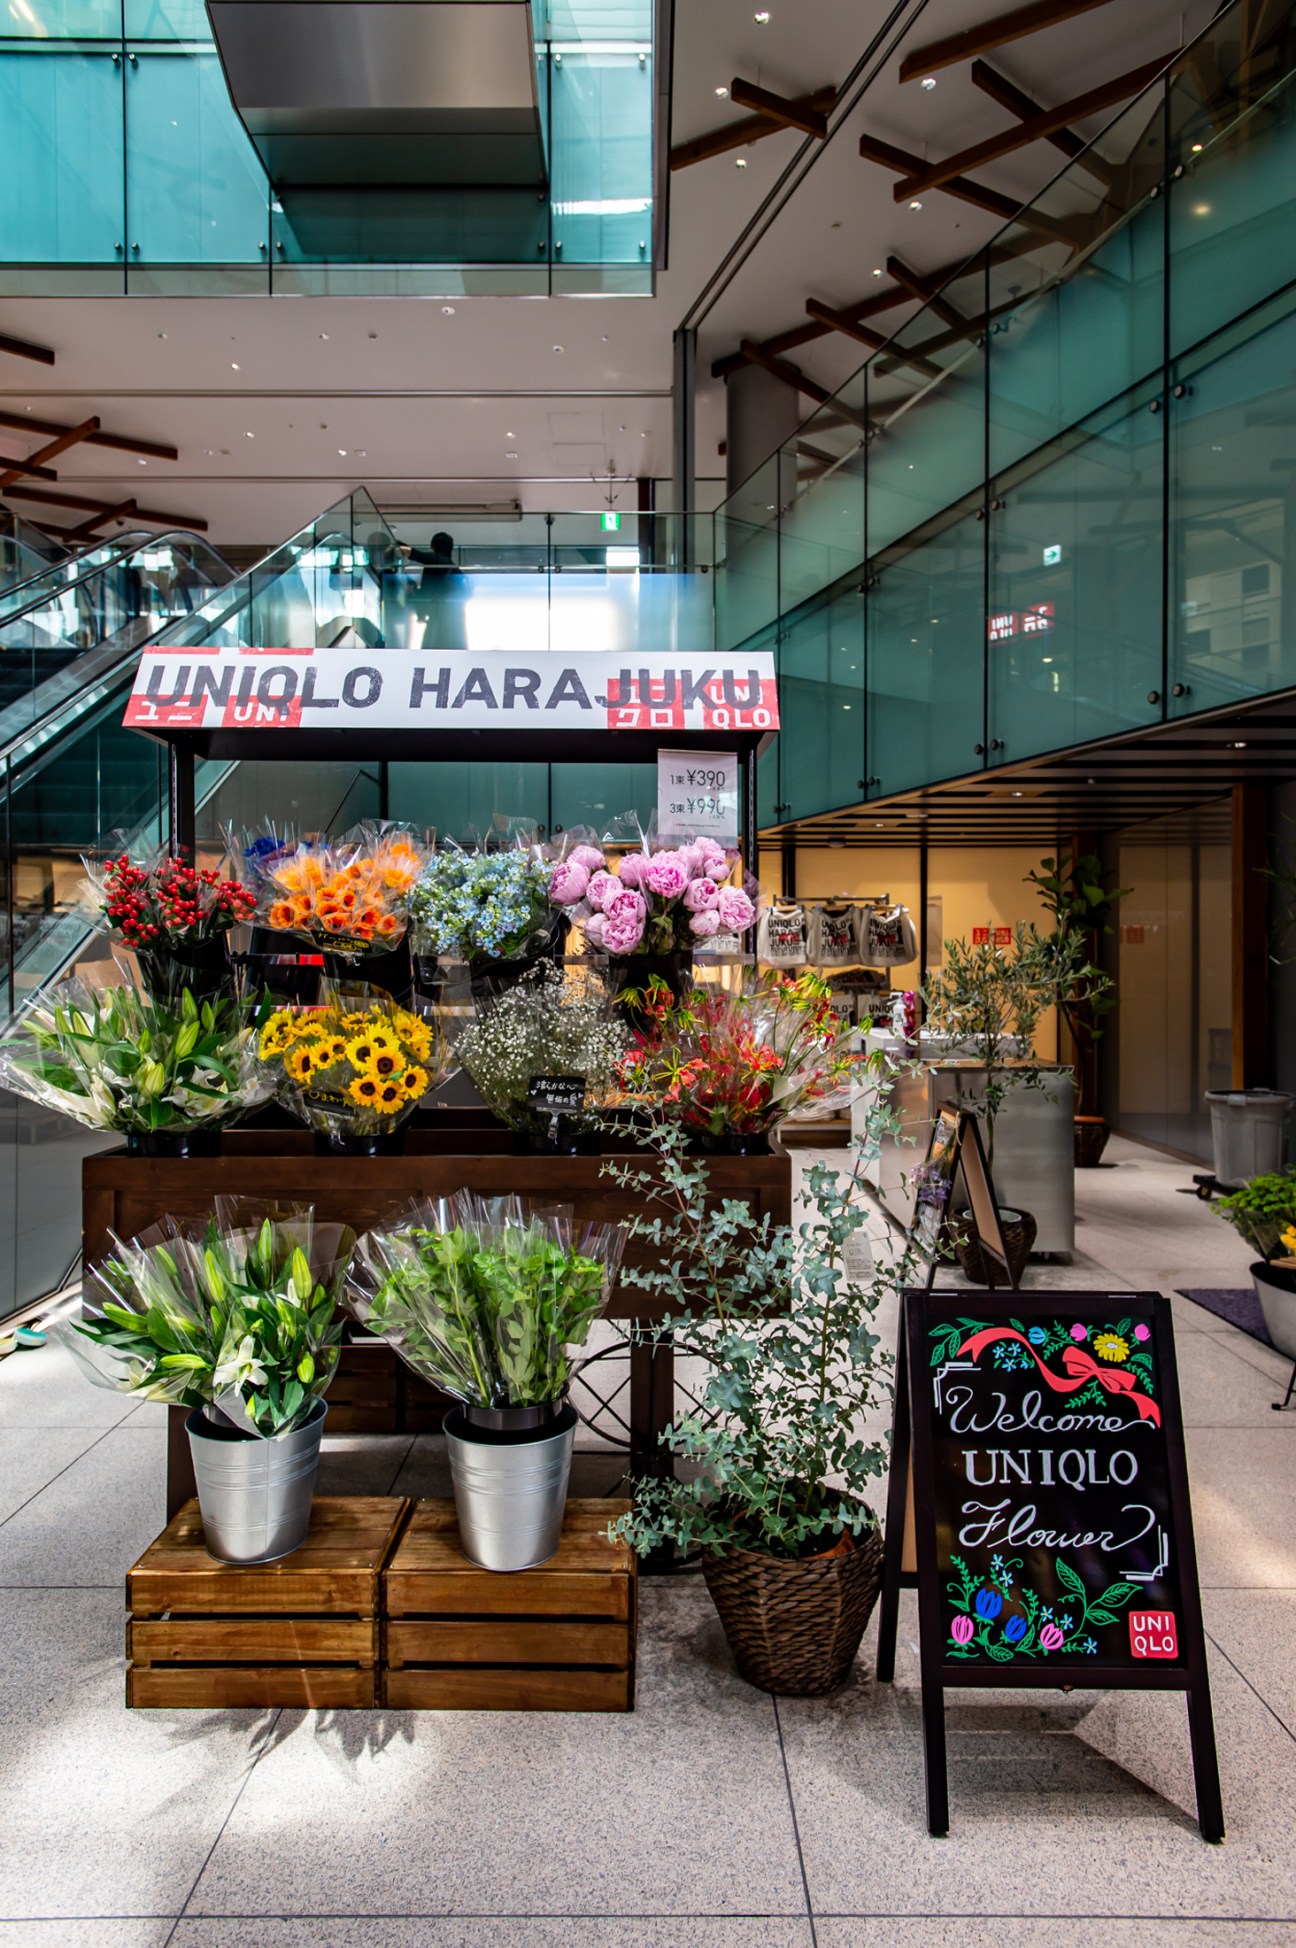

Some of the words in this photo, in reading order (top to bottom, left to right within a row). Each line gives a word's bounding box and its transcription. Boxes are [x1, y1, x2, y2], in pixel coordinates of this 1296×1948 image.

[145, 665, 384, 716] UNIQLO
[409, 667, 761, 710] HARAJUKU
[616, 708, 673, 727] クロ
[712, 708, 770, 730] QLO
[686, 768, 725, 787] ¥390
[945, 1386, 1156, 1433] Welcome
[961, 1449, 1138, 1491] UNIQLO
[959, 1498, 1156, 1551] Flower
[1133, 1615, 1170, 1632] UNI
[1134, 1635, 1174, 1656] QLO
